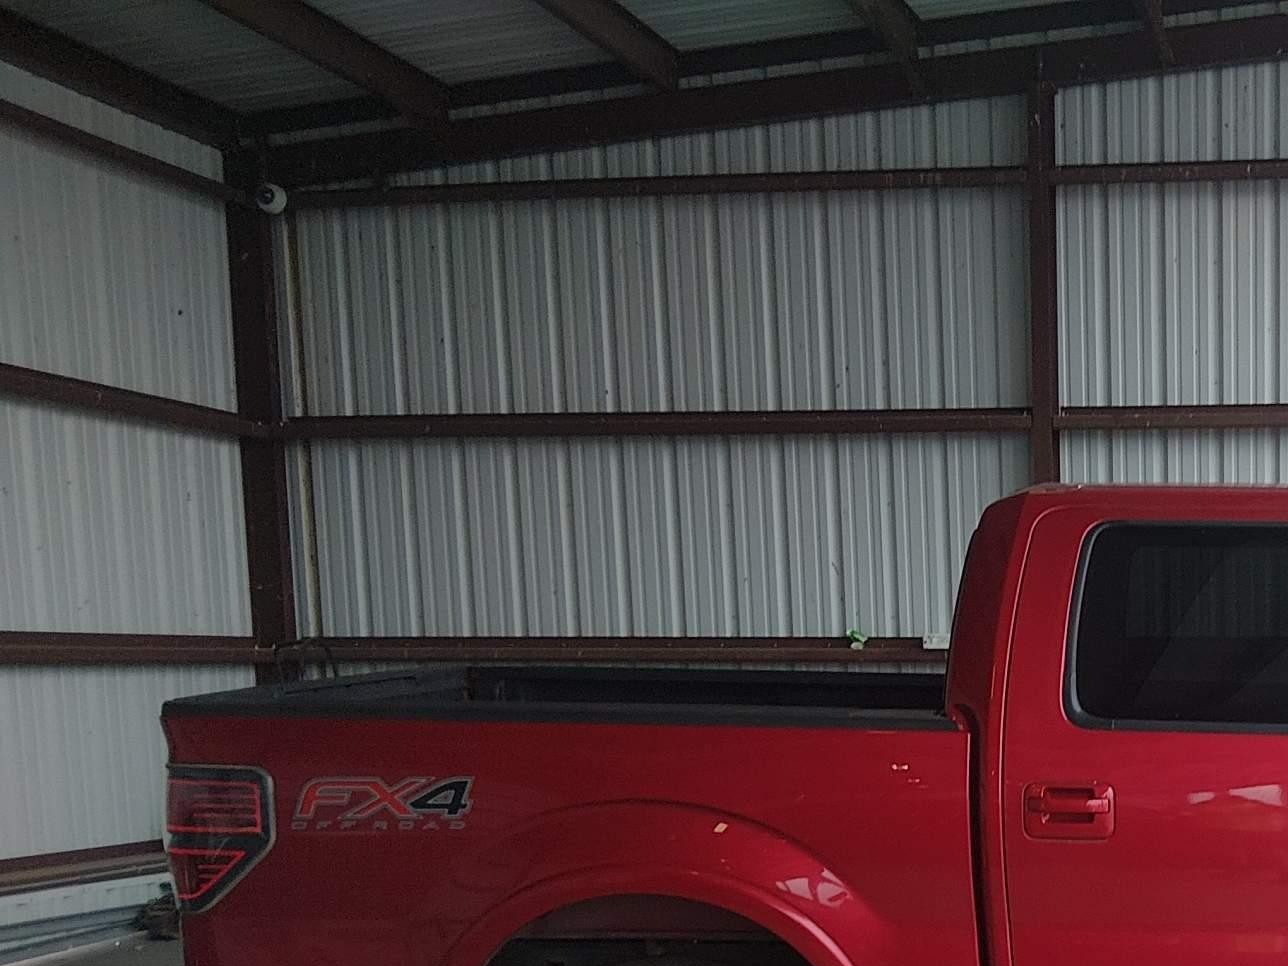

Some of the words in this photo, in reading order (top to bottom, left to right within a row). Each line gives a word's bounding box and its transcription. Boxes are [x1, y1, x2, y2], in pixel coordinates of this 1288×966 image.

[295, 776, 475, 819] FX4
[291, 820, 356, 831] OFF
[373, 820, 466, 831] ROAD
